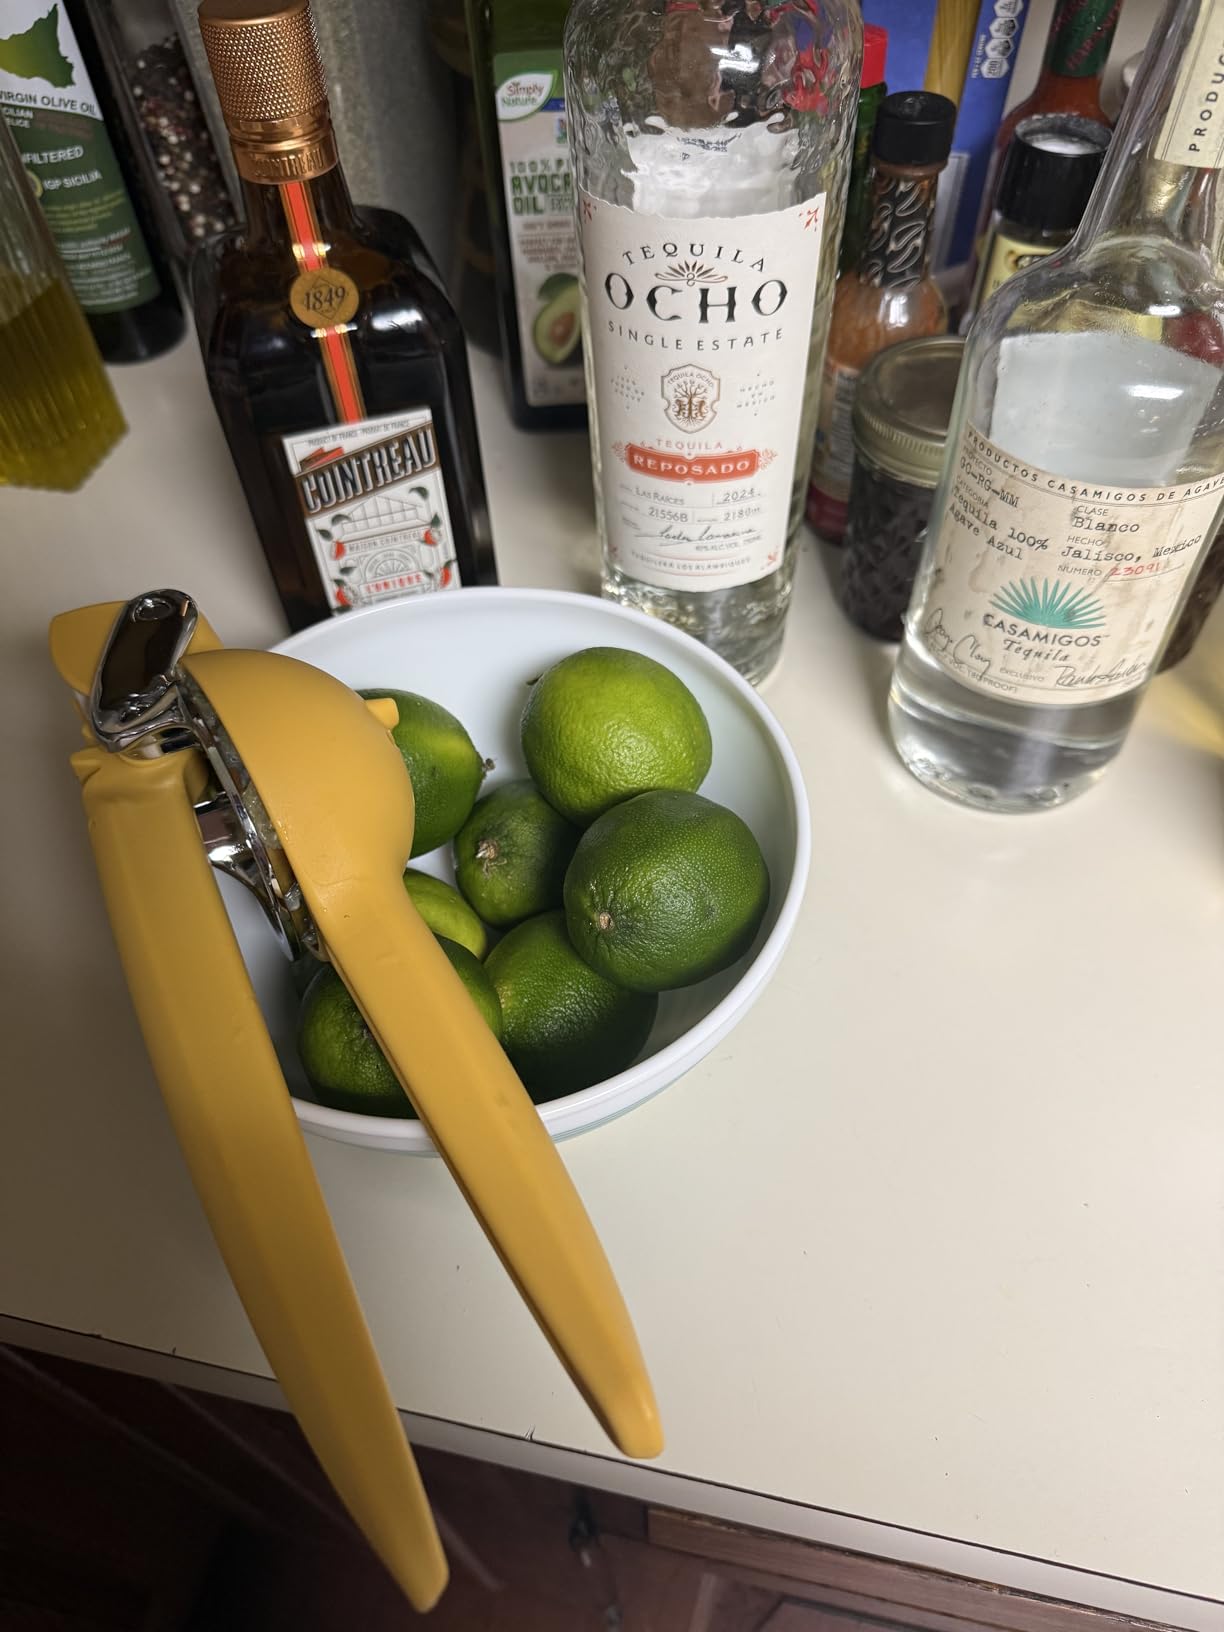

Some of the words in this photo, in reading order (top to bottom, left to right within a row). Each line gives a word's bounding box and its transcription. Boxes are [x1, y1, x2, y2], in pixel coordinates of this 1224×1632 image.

[41, 95, 77, 111] OLIVE
[80, 102, 96, 116] OIL
[513, 196, 544, 215] OIL
[622, 242, 766, 272] TEQUILA
[304, 287, 345, 312] 1849
[604, 272, 788, 324] OCHO
[608, 320, 683, 350] SINGLE
[697, 328, 783, 351] ESTATE
[656, 438, 722, 450] TEQUILA
[302, 429, 437, 514] COINTREAU
[633, 454, 750, 475] REPOSADO
[967, 430, 1039, 482] PRODUCTOS
[1047, 479, 1147, 502] CASAMIGOS
[1156, 491, 1176, 501] DE
[1076, 505, 1109, 516] CLASE
[948, 502, 981, 537] Agave
[986, 535, 1023, 561] Azul
[1071, 515, 1141, 533] Blanco
[1007, 527, 1050, 551] 100%
[1060, 545, 1142, 564] Jalisco,
[1152, 534, 1202, 559] Mexico
[1066, 535, 1104, 547] HECHO
[1057, 564, 1102, 577] NUMERO
[982, 613, 1101, 648] CASAMIGOS
[1003, 638, 1069, 662] Tequila
